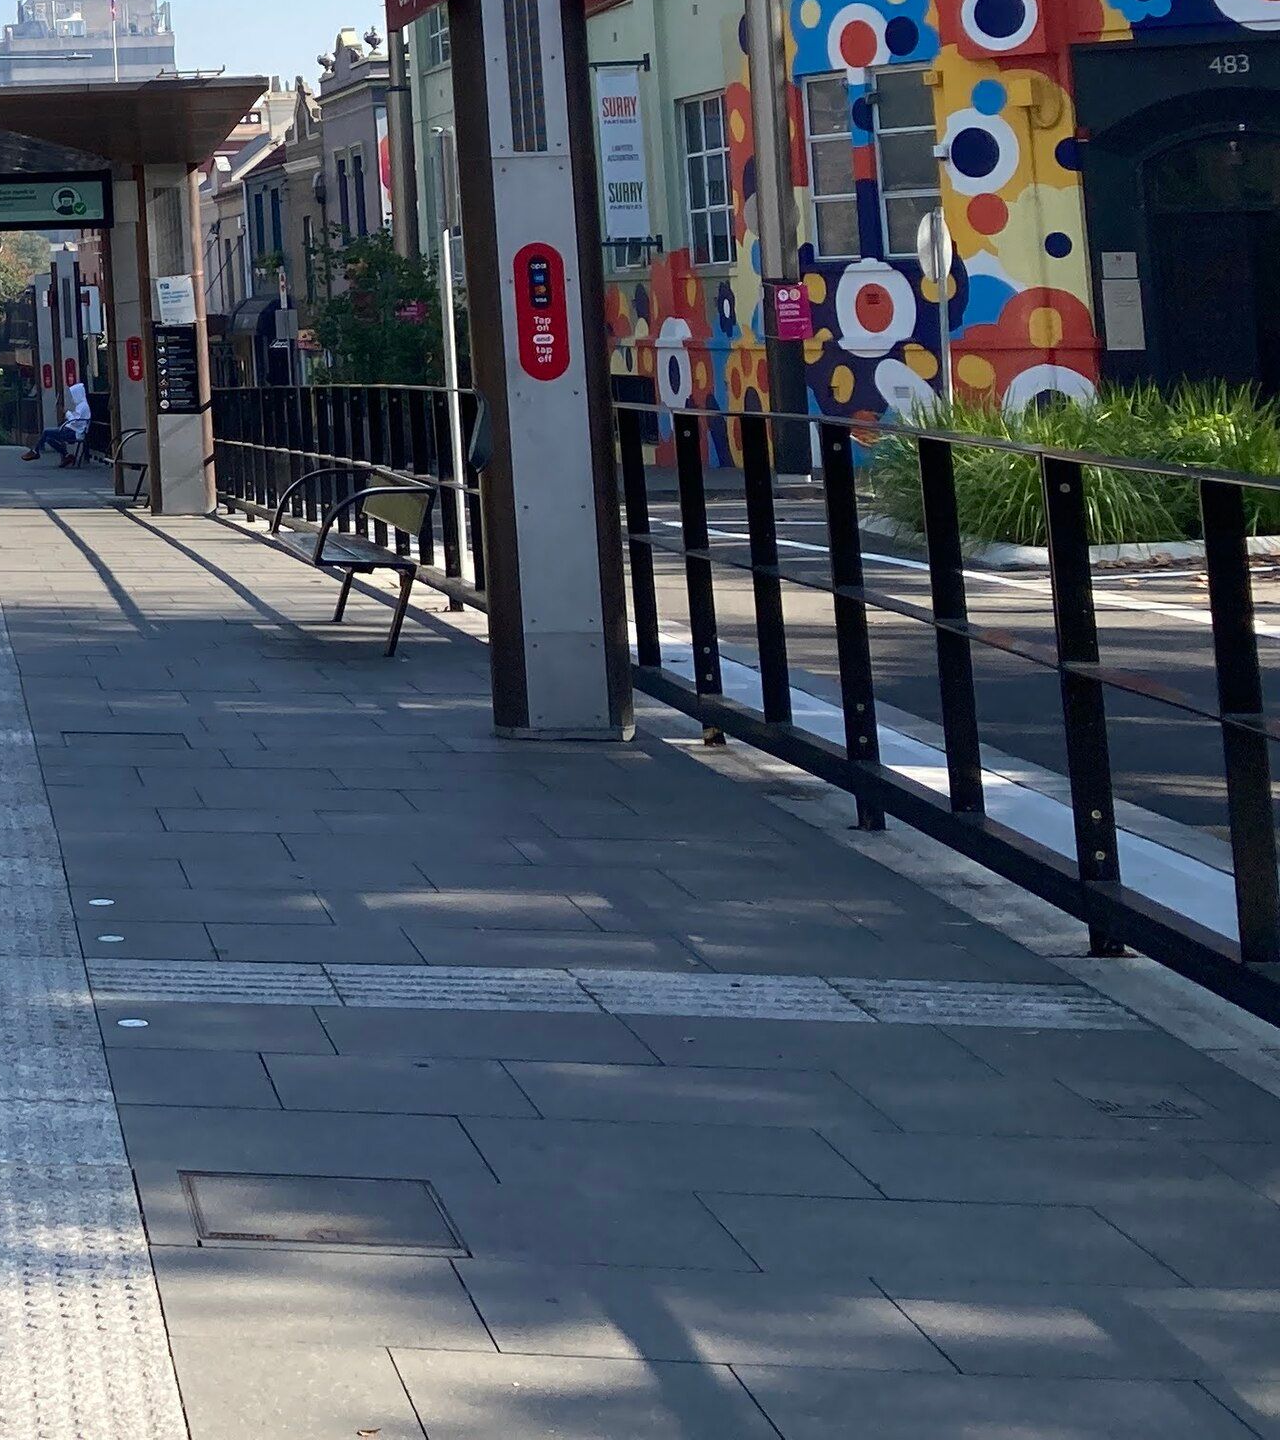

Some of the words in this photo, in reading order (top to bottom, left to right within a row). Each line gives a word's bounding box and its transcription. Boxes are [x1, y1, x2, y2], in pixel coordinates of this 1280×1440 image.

[1209, 54, 1249, 74] 483
[602, 96, 637, 117] SURRY
[608, 182, 643, 203] SURRY
[533, 316, 551, 325] Tap
[536, 346, 553, 354] tap
[538, 354, 552, 363] off
